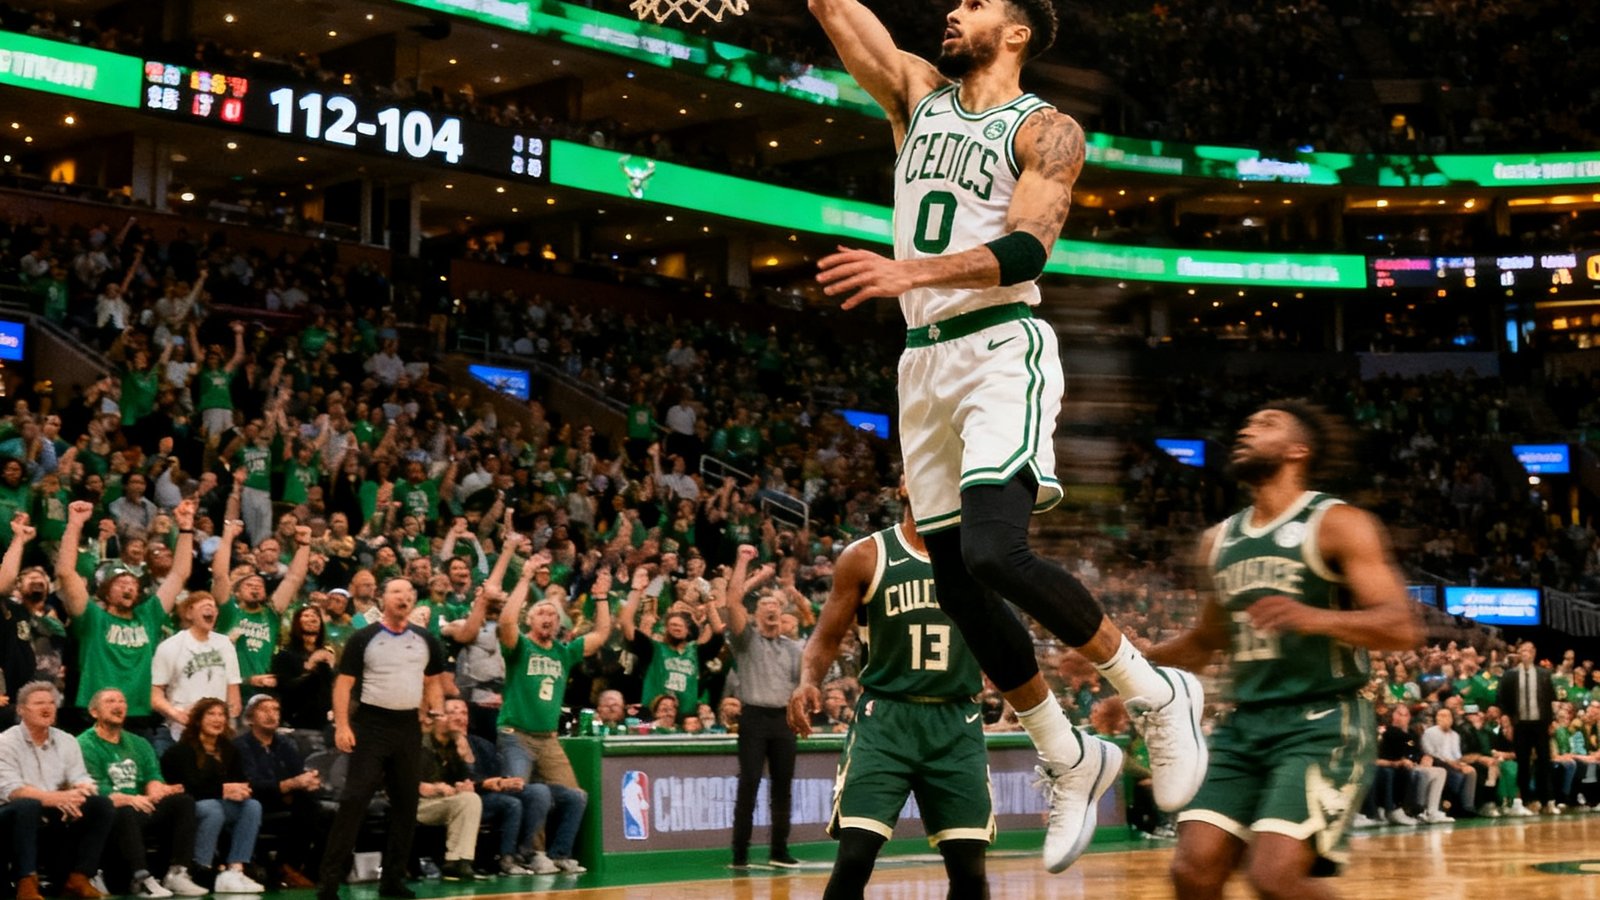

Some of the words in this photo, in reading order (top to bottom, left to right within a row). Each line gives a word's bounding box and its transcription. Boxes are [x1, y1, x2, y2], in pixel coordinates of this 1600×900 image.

[270, 88, 463, 164] 112-104
[905, 132, 999, 201] CELTICS
[913, 190, 958, 254] 0
[909, 624, 951, 671] 13
